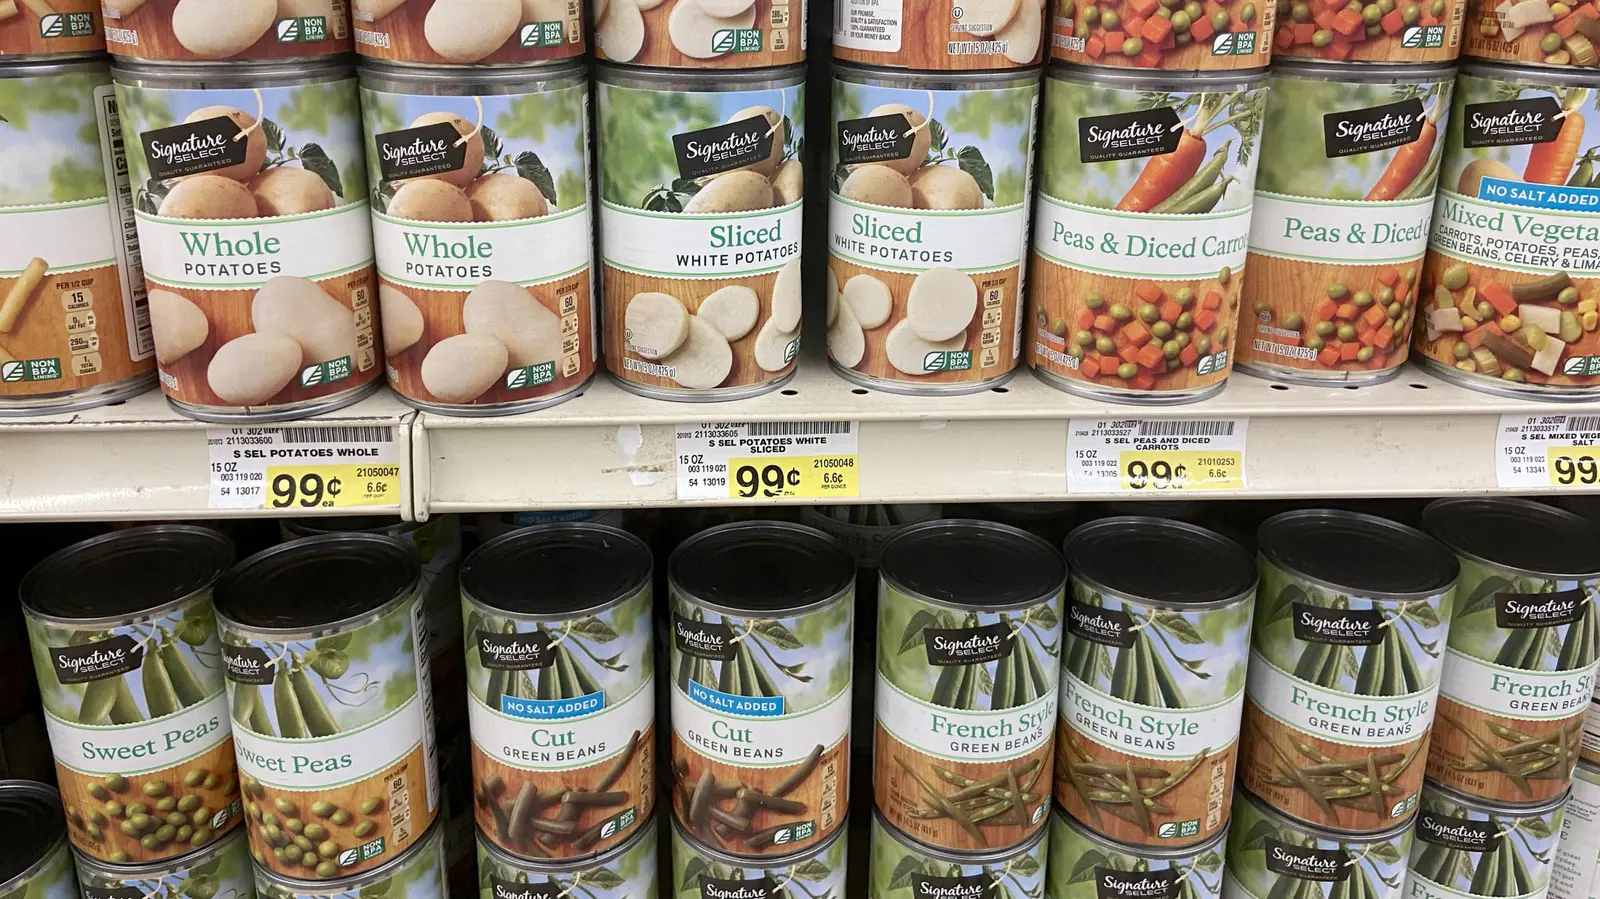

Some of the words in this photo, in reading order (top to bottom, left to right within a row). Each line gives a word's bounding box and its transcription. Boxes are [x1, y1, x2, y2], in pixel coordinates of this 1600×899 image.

[70, 13, 91, 23] NON
[71, 21, 92, 31] BPA
[741, 30, 759, 39] NON
[741, 38, 759, 47] BPA
[1335, 112, 1412, 142] Signature
[1470, 110, 1545, 135] Signature
[1491, 124, 1542, 135] SELECT
[842, 127, 898, 151] Signature
[1088, 121, 1165, 149] Signature
[1111, 135, 1165, 148] SELECT
[1362, 125, 1410, 141] SELECT
[151, 131, 227, 164] Signature
[382, 138, 448, 163] Signature
[686, 130, 760, 162] Signature
[711, 144, 759, 160] SELECT
[856, 140, 896, 151] SELECT
[174, 146, 226, 164] SELECT
[401, 152, 447, 166] SELECT
[159, 169, 182, 177] QUALITY
[184, 158, 232, 173] GUARANTEED
[1487, 185, 1508, 198] NO
[1512, 189, 1547, 202] SALT
[1547, 192, 1599, 206] ADDED
[852, 214, 923, 245] Sliced
[1283, 217, 1340, 244] Peas
[1346, 223, 1366, 244] &
[1371, 220, 1423, 244] Diced
[1442, 200, 1505, 232] Mixed
[1513, 214, 1599, 244] Vegeta
[709, 220, 781, 248] Sliced
[1053, 220, 1094, 252] Peas
[1101, 234, 1120, 254] &
[1125, 235, 1196, 259] Diced
[1439, 224, 1483, 246] CARROTS,
[1486, 238, 1559, 257] POTATOES,
[179, 231, 281, 258] Whole
[403, 232, 493, 260] Whole
[834, 233, 866, 256] WHITE
[870, 246, 953, 263] POTATOES
[1433, 233, 1458, 250] GREEN
[1459, 243, 1500, 261] BEANS,
[1504, 252, 1559, 268] CELERY
[1561, 259, 1570, 268] &
[1574, 259, 1600, 269] LIMA
[676, 253, 729, 267] WHITE
[735, 241, 798, 265] POTATOES
[185, 261, 281, 277] POTATOES
[406, 262, 492, 278] POTATOES
[30, 359, 56, 368] NON
[32, 366, 57, 376] BPA
[227, 437, 273, 445] 2113033600
[695, 430, 738, 438] 2113033605
[709, 439, 715, 447] S
[718, 439, 736, 447] SEL
[740, 438, 792, 446] POTATOES
[794, 437, 827, 445] WHITE
[234, 450, 241, 458] S
[245, 450, 266, 458] SEL
[271, 449, 333, 458] POTATOES
[337, 448, 379, 457] WHOLE
[679, 456, 689, 464] 15
[691, 455, 703, 464] OZ
[1086, 450, 1097, 458] OZ
[211, 463, 222, 472] 15
[224, 463, 237, 472] OZ
[702, 465, 713, 473] 119
[814, 459, 854, 468] 21050048
[1198, 458, 1235, 466] 21010253
[221, 473, 233, 481] 003
[235, 473, 248, 481] 119
[357, 468, 399, 477] 21050047
[824, 473, 843, 483] 6.6¢
[1209, 469, 1226, 477] 6.6¢
[236, 487, 260, 495] 13017
[367, 482, 387, 492] 6.6¢
[689, 479, 698, 487] 54
[703, 478, 726, 486] 13019
[1505, 598, 1576, 621] Signature
[1529, 610, 1574, 619] SELECT
[1071, 606, 1123, 631] Signature
[1301, 612, 1372, 635] Signature
[1084, 624, 1121, 638] SELECT
[1322, 628, 1370, 637] SELECT
[482, 638, 541, 661] Signature
[933, 634, 1001, 656] Signature
[956, 644, 1000, 656] SELECT
[59, 646, 126, 673] Signature
[80, 657, 126, 673] SELECT
[500, 652, 540, 661] SELECT
[1491, 673, 1571, 698] French
[507, 702, 524, 713] NO
[527, 702, 555, 714] SALT
[557, 698, 598, 713] ADDED
[692, 687, 708, 699] NO
[709, 693, 732, 706] SALT
[735, 699, 777, 712] ADDED
[1510, 699, 1551, 711] GREEN
[1064, 682, 1133, 730] French
[1139, 715, 1199, 739] Style
[1291, 686, 1378, 723] French
[1383, 700, 1428, 733] Style
[711, 720, 752, 743] Cut
[930, 714, 1013, 739] French
[1076, 715, 1119, 741] GREEN
[1124, 734, 1176, 751] BEANS
[1308, 716, 1361, 737] GREEN
[1366, 723, 1412, 737] BEANS
[81, 741, 156, 761] Sweet
[163, 716, 220, 751] Peas
[531, 728, 576, 748] Cut
[688, 730, 728, 755] GREEN
[734, 746, 783, 758] BEANS
[950, 741, 1000, 753] GREEN
[1005, 728, 1043, 750] BEANS
[503, 746, 552, 762] GREEN
[557, 741, 606, 761] BEANS
[293, 753, 352, 775] Peas
[1182, 821, 1198, 829] NON
[1182, 827, 1198, 836] BPA
[1422, 816, 1487, 840] Signature
[1442, 834, 1486, 844] SELECT
